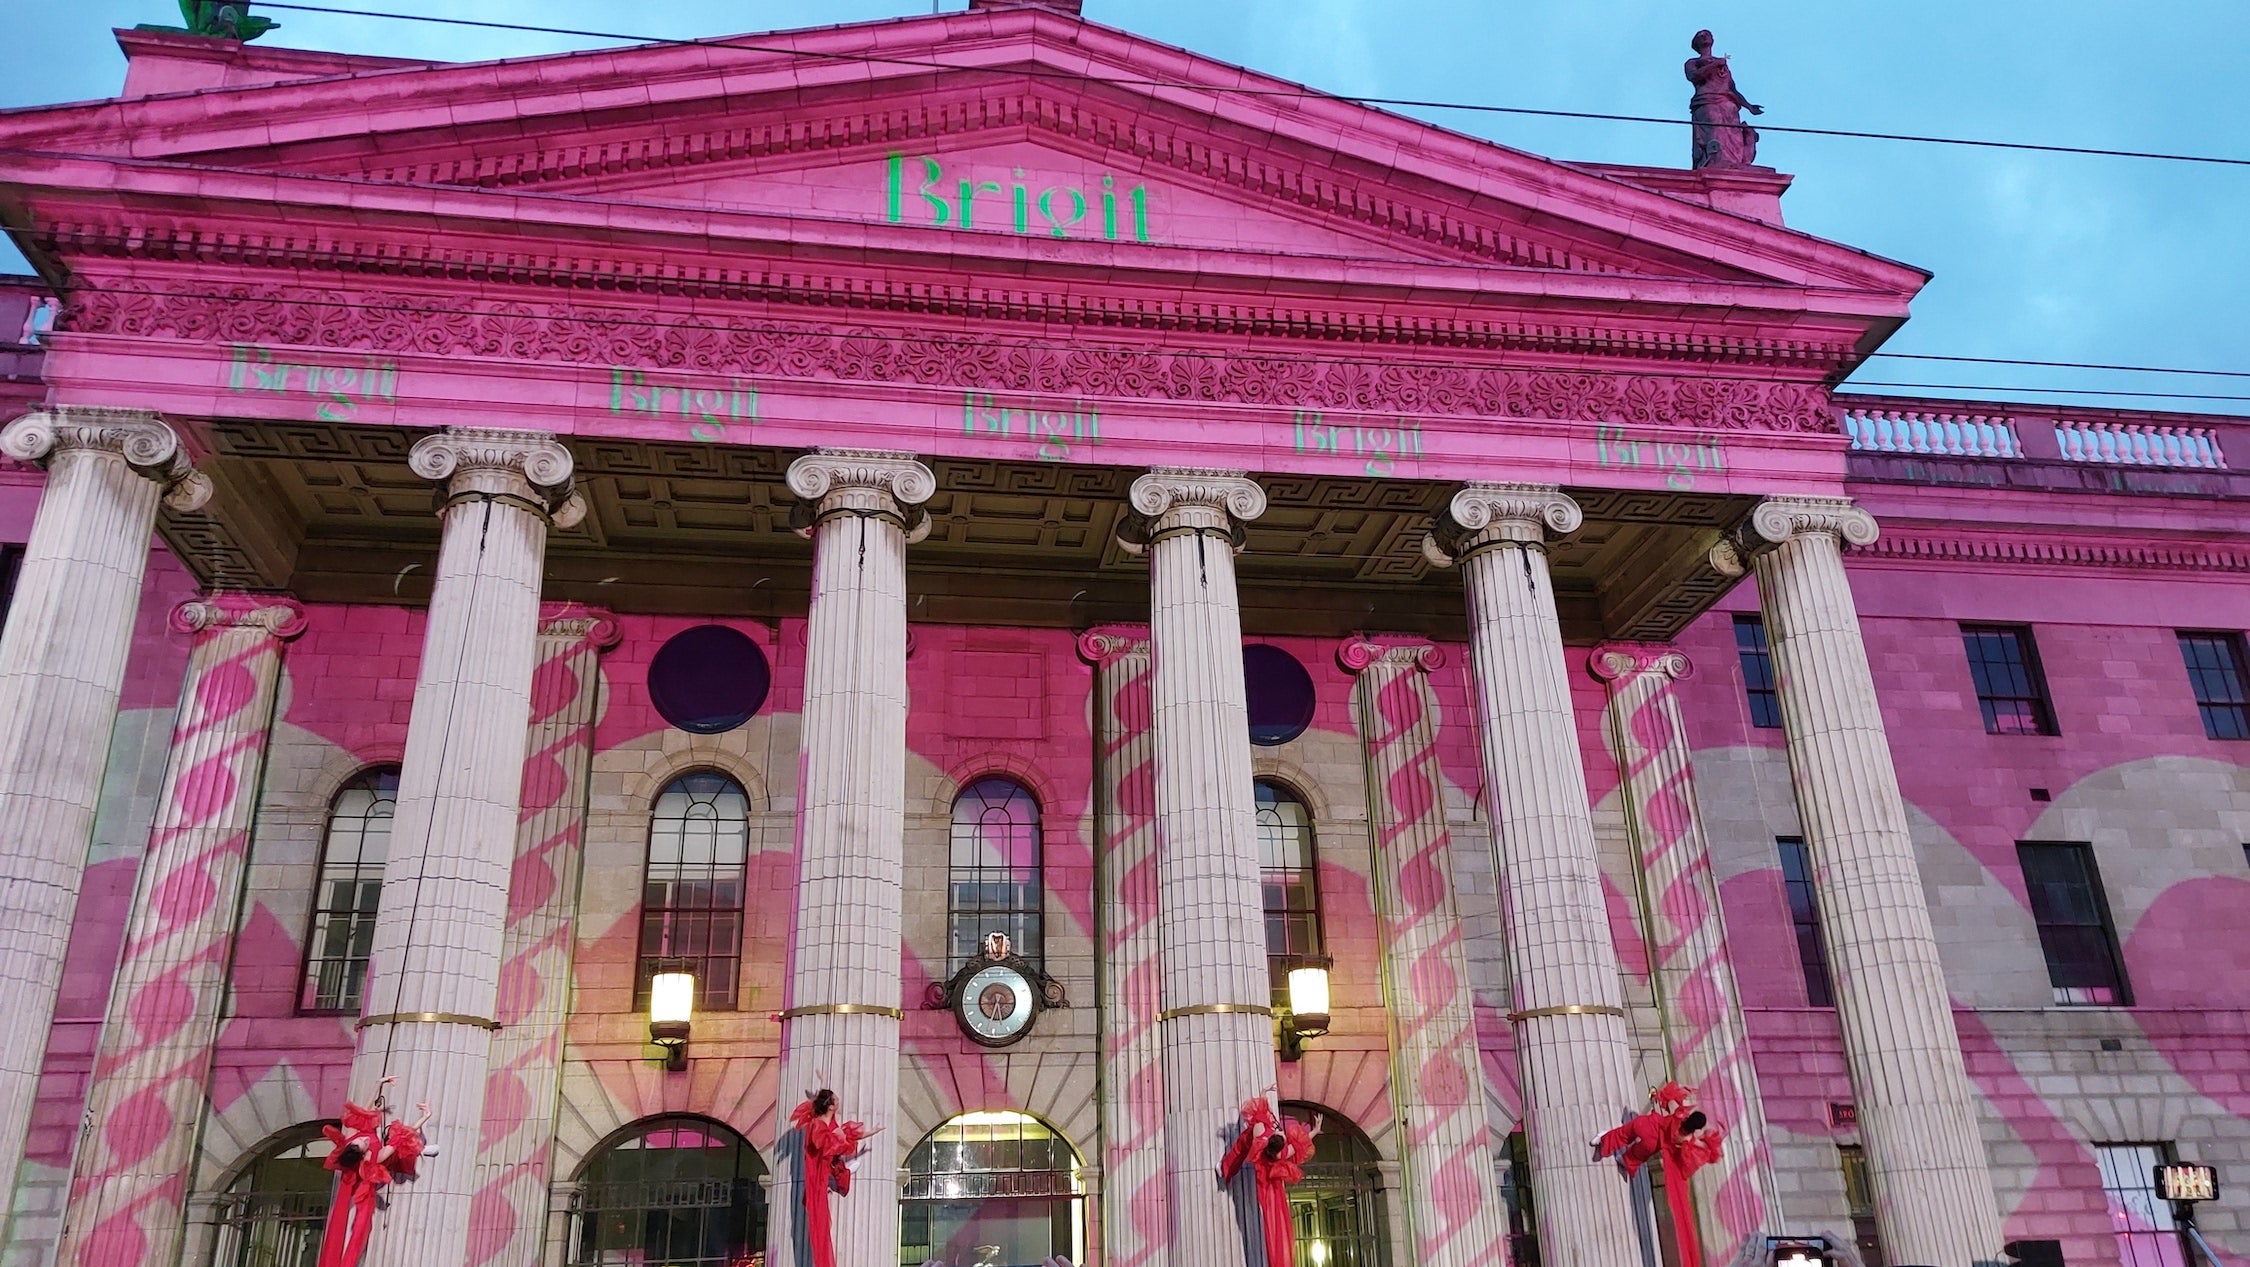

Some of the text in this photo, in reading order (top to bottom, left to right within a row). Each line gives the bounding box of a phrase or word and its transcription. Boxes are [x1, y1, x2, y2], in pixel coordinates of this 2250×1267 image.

[887, 151, 1163, 243] Brigit
[230, 341, 396, 421] Brigit
[611, 366, 763, 442] Brigit
[964, 387, 1102, 462] Brigit
[1294, 408, 1425, 477] Brigit
[1597, 423, 1724, 489] Brigit
